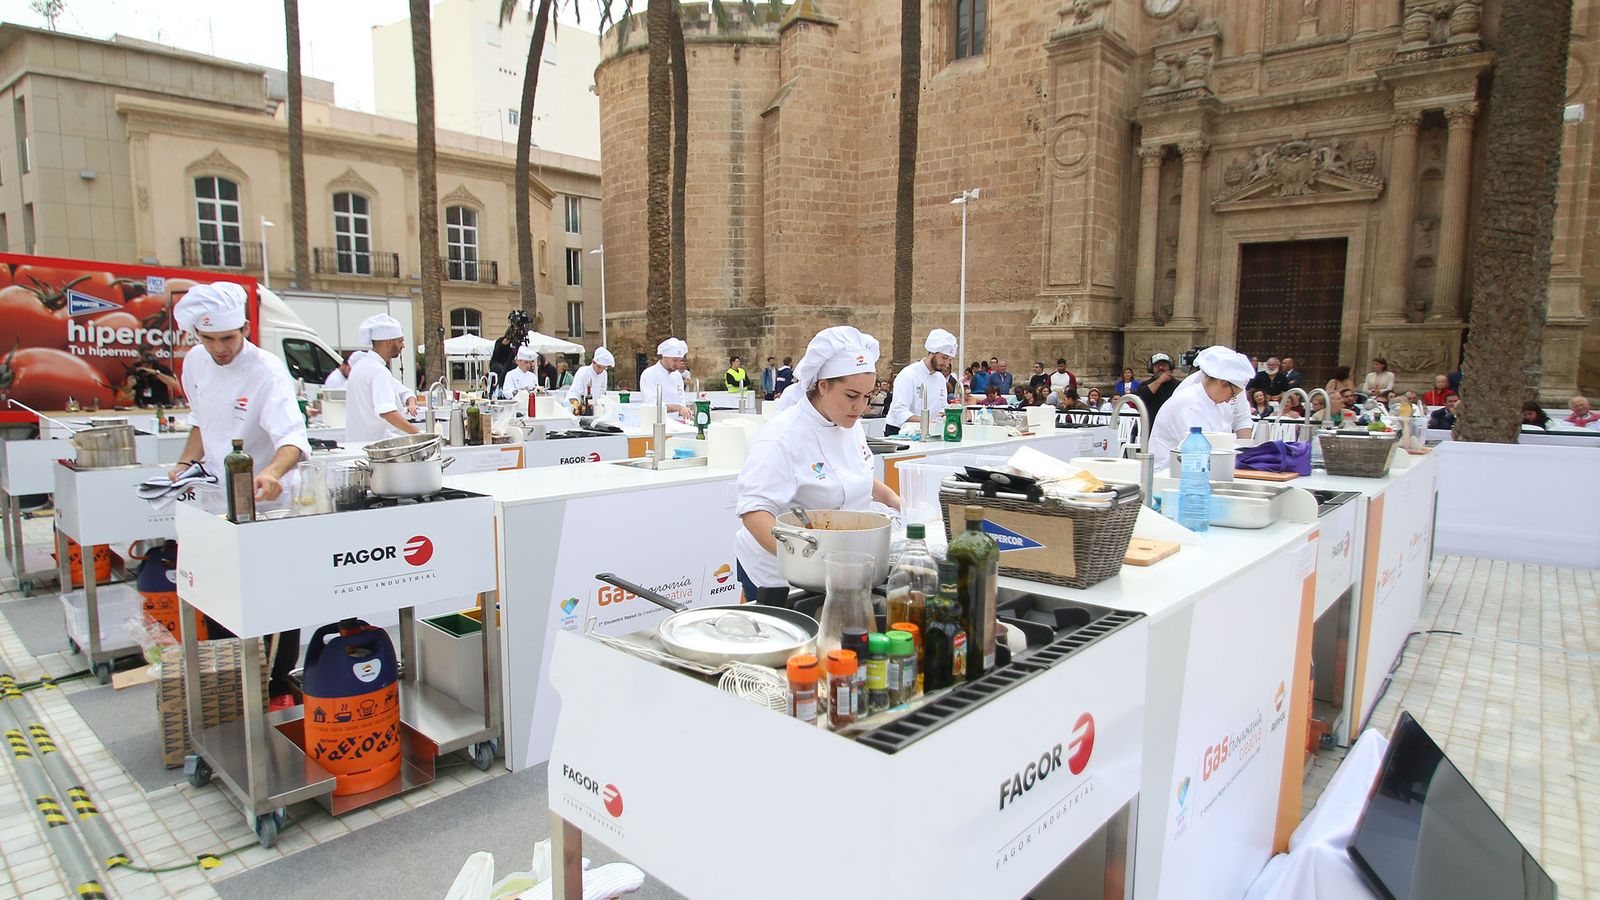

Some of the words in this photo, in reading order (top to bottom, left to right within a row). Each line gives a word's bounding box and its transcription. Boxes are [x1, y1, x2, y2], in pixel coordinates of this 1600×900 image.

[69, 345, 85, 355] Tu
[560, 456, 586, 465] FAGOR
[333, 546, 397, 567] FAGOR
[334, 584, 369, 595] FAGOR
[376, 572, 437, 588] INDUSTRIAL
[710, 583, 736, 596] REPSOL
[563, 763, 599, 796] FAGOR
[999, 743, 1063, 811] FAGOR
[995, 834, 1032, 871] FAGOR
[1037, 783, 1095, 835] INDUSTRIAL
